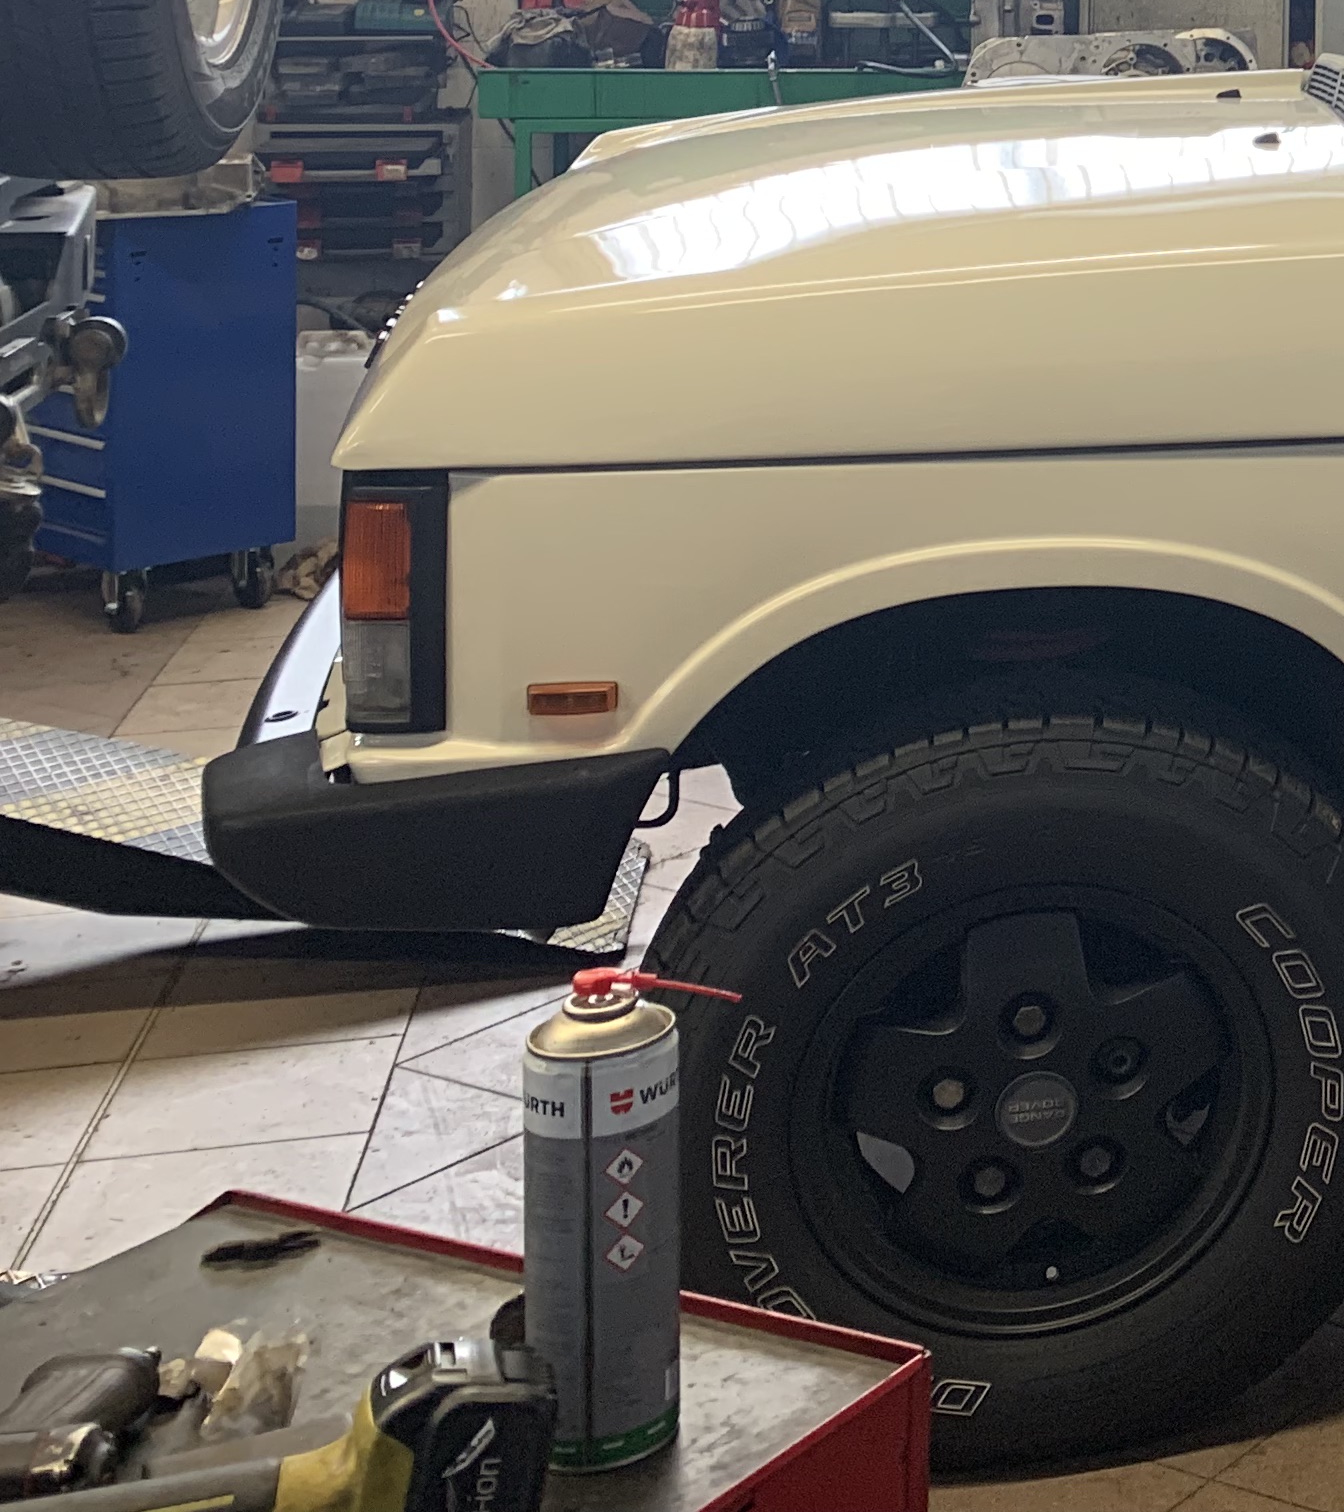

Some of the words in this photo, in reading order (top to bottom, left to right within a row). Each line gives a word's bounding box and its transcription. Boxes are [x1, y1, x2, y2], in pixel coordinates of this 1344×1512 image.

[786, 860, 926, 988] AT3
[639, 1071, 677, 1104] WÜR
[523, 1092, 565, 1118] ÜRTH
